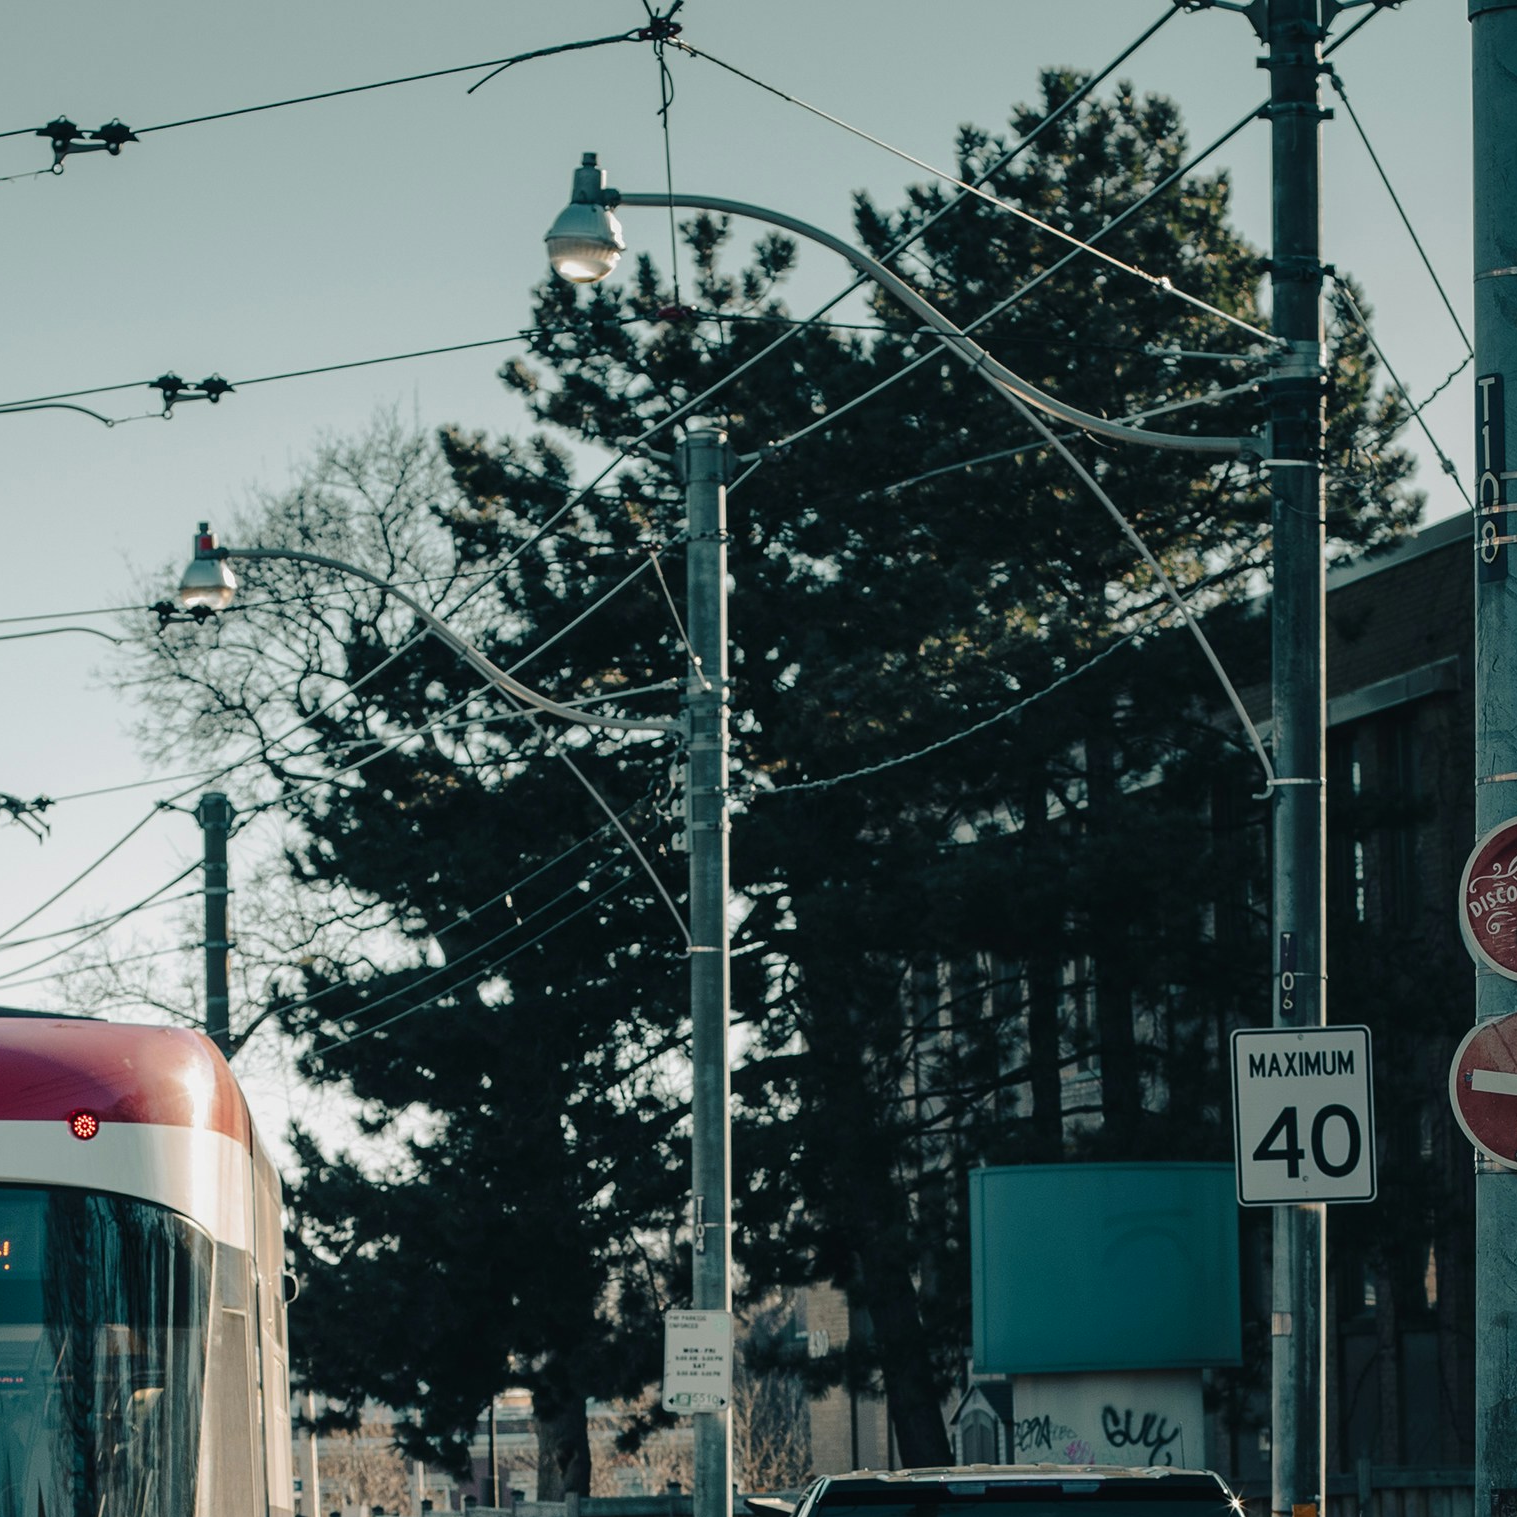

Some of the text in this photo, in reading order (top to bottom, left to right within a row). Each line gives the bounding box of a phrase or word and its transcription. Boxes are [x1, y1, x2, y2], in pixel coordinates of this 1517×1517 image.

[1478, 376, 1500, 564] T108
[1248, 1049, 1355, 1078] MAXIMUM
[1252, 1103, 1362, 1179] 40
